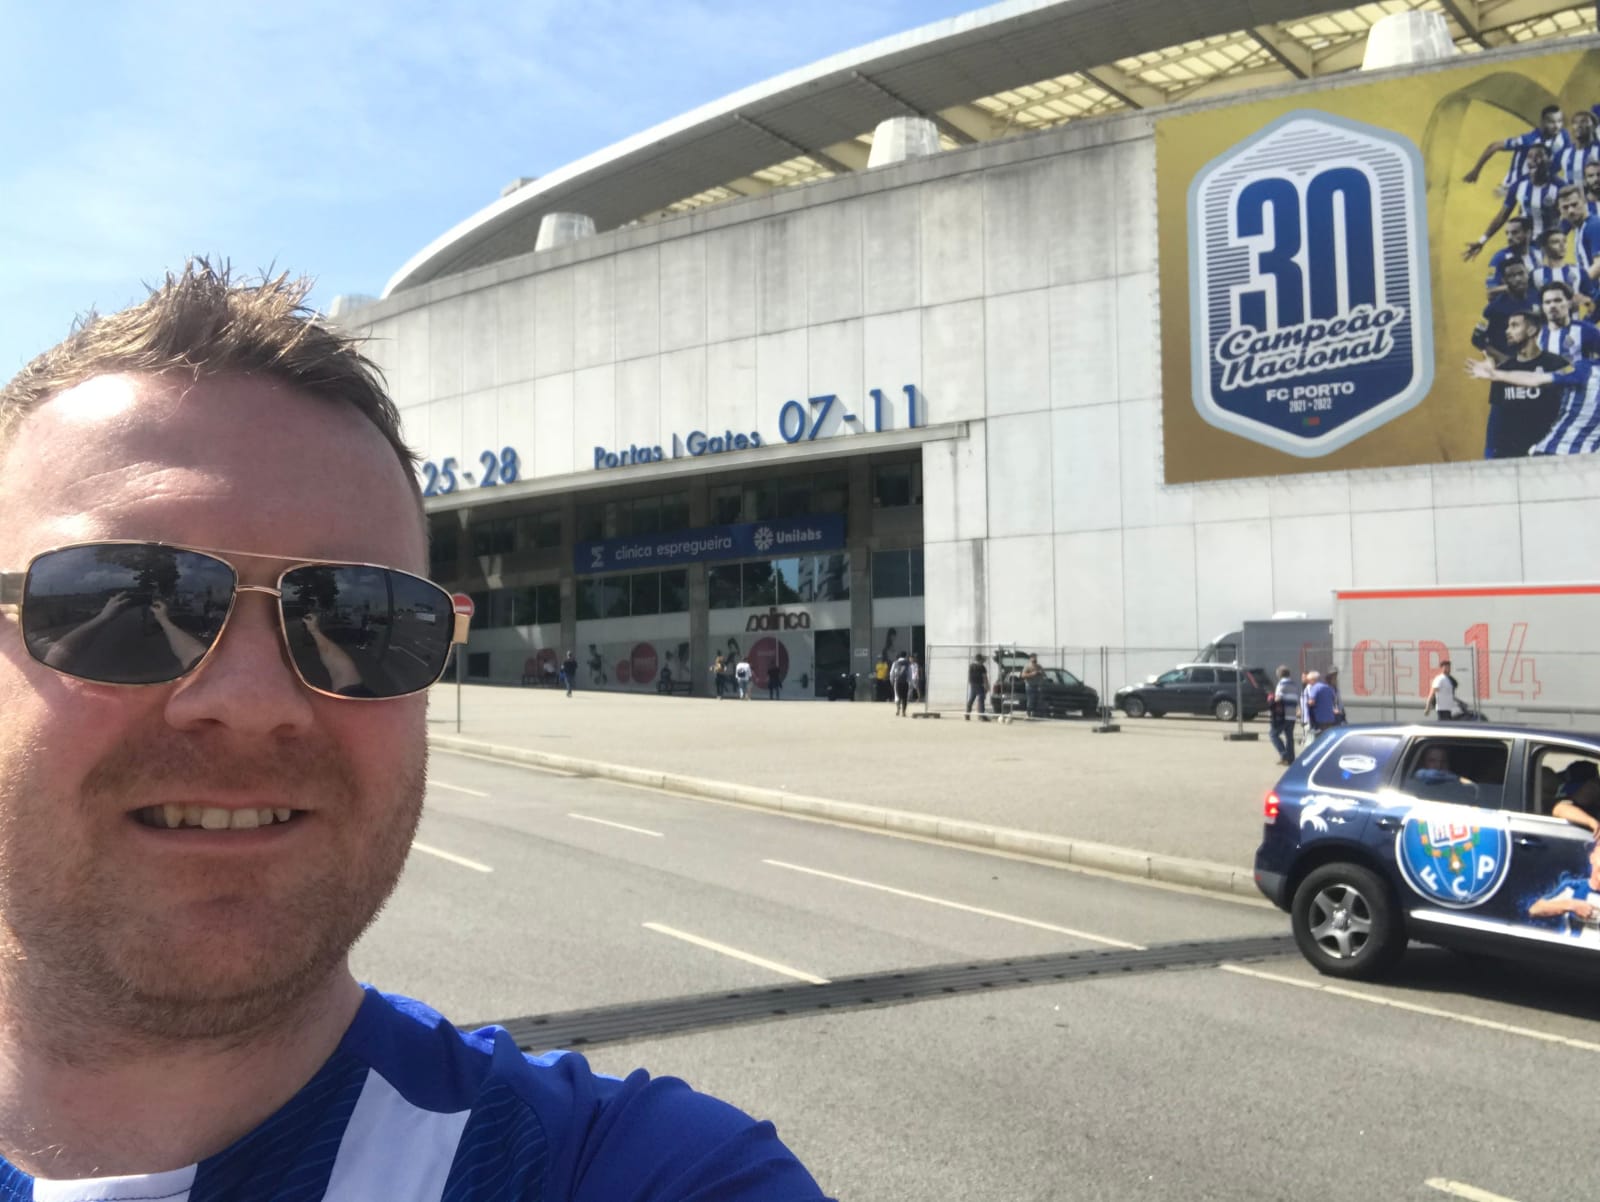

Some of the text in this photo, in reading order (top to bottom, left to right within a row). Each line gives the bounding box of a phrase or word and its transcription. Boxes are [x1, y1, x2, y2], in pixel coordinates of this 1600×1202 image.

[1236, 167, 1377, 332] 30
[1219, 309, 1401, 360] Campeão
[1225, 330, 1389, 387] Nacional
[1266, 381, 1355, 402] FC PORTO
[422, 446, 518, 497] 25-28
[594, 444, 663, 470] Portas
[686, 428, 760, 456] Gates
[657, 535, 732, 557] espregueira
[776, 529, 822, 544] Unilabs
[1464, 622, 1541, 700] 14
